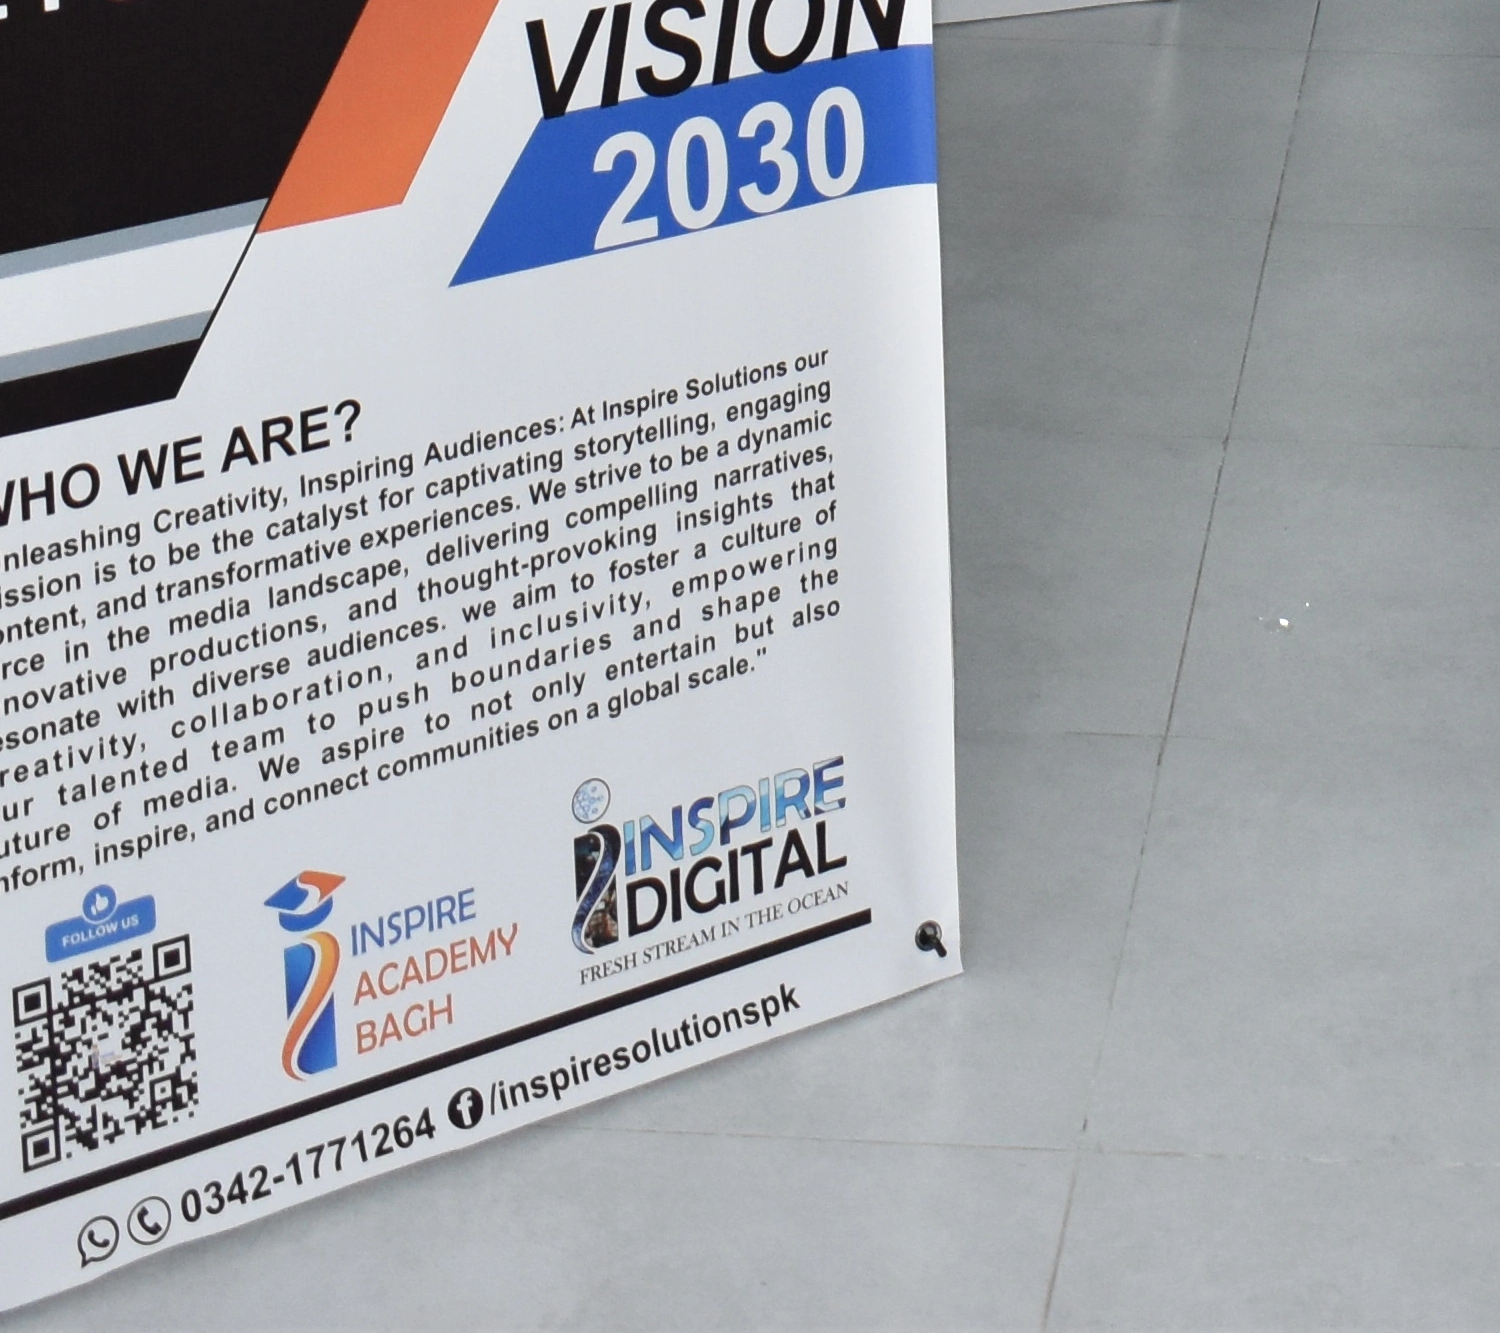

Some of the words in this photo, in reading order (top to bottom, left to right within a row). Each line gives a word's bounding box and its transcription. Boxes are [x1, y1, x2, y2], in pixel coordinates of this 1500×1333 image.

[593, 86, 864, 250] 2030
[118, 436, 204, 495] WE
[221, 400, 360, 473] ARE?
[624, 755, 846, 874] INSPIRE
[352, 888, 476, 956] INSPIRE
[626, 821, 847, 937] DIGITAL
[354, 923, 517, 1005] ACADEMY
[581, 952, 636, 985] FRESH
[643, 926, 715, 964] STREAM
[722, 918, 739, 937] IN
[745, 905, 783, 928] THE
[788, 881, 847, 914] OCEAN
[356, 994, 452, 1054] BAGH
[181, 1108, 435, 1222] 0342-1771264
